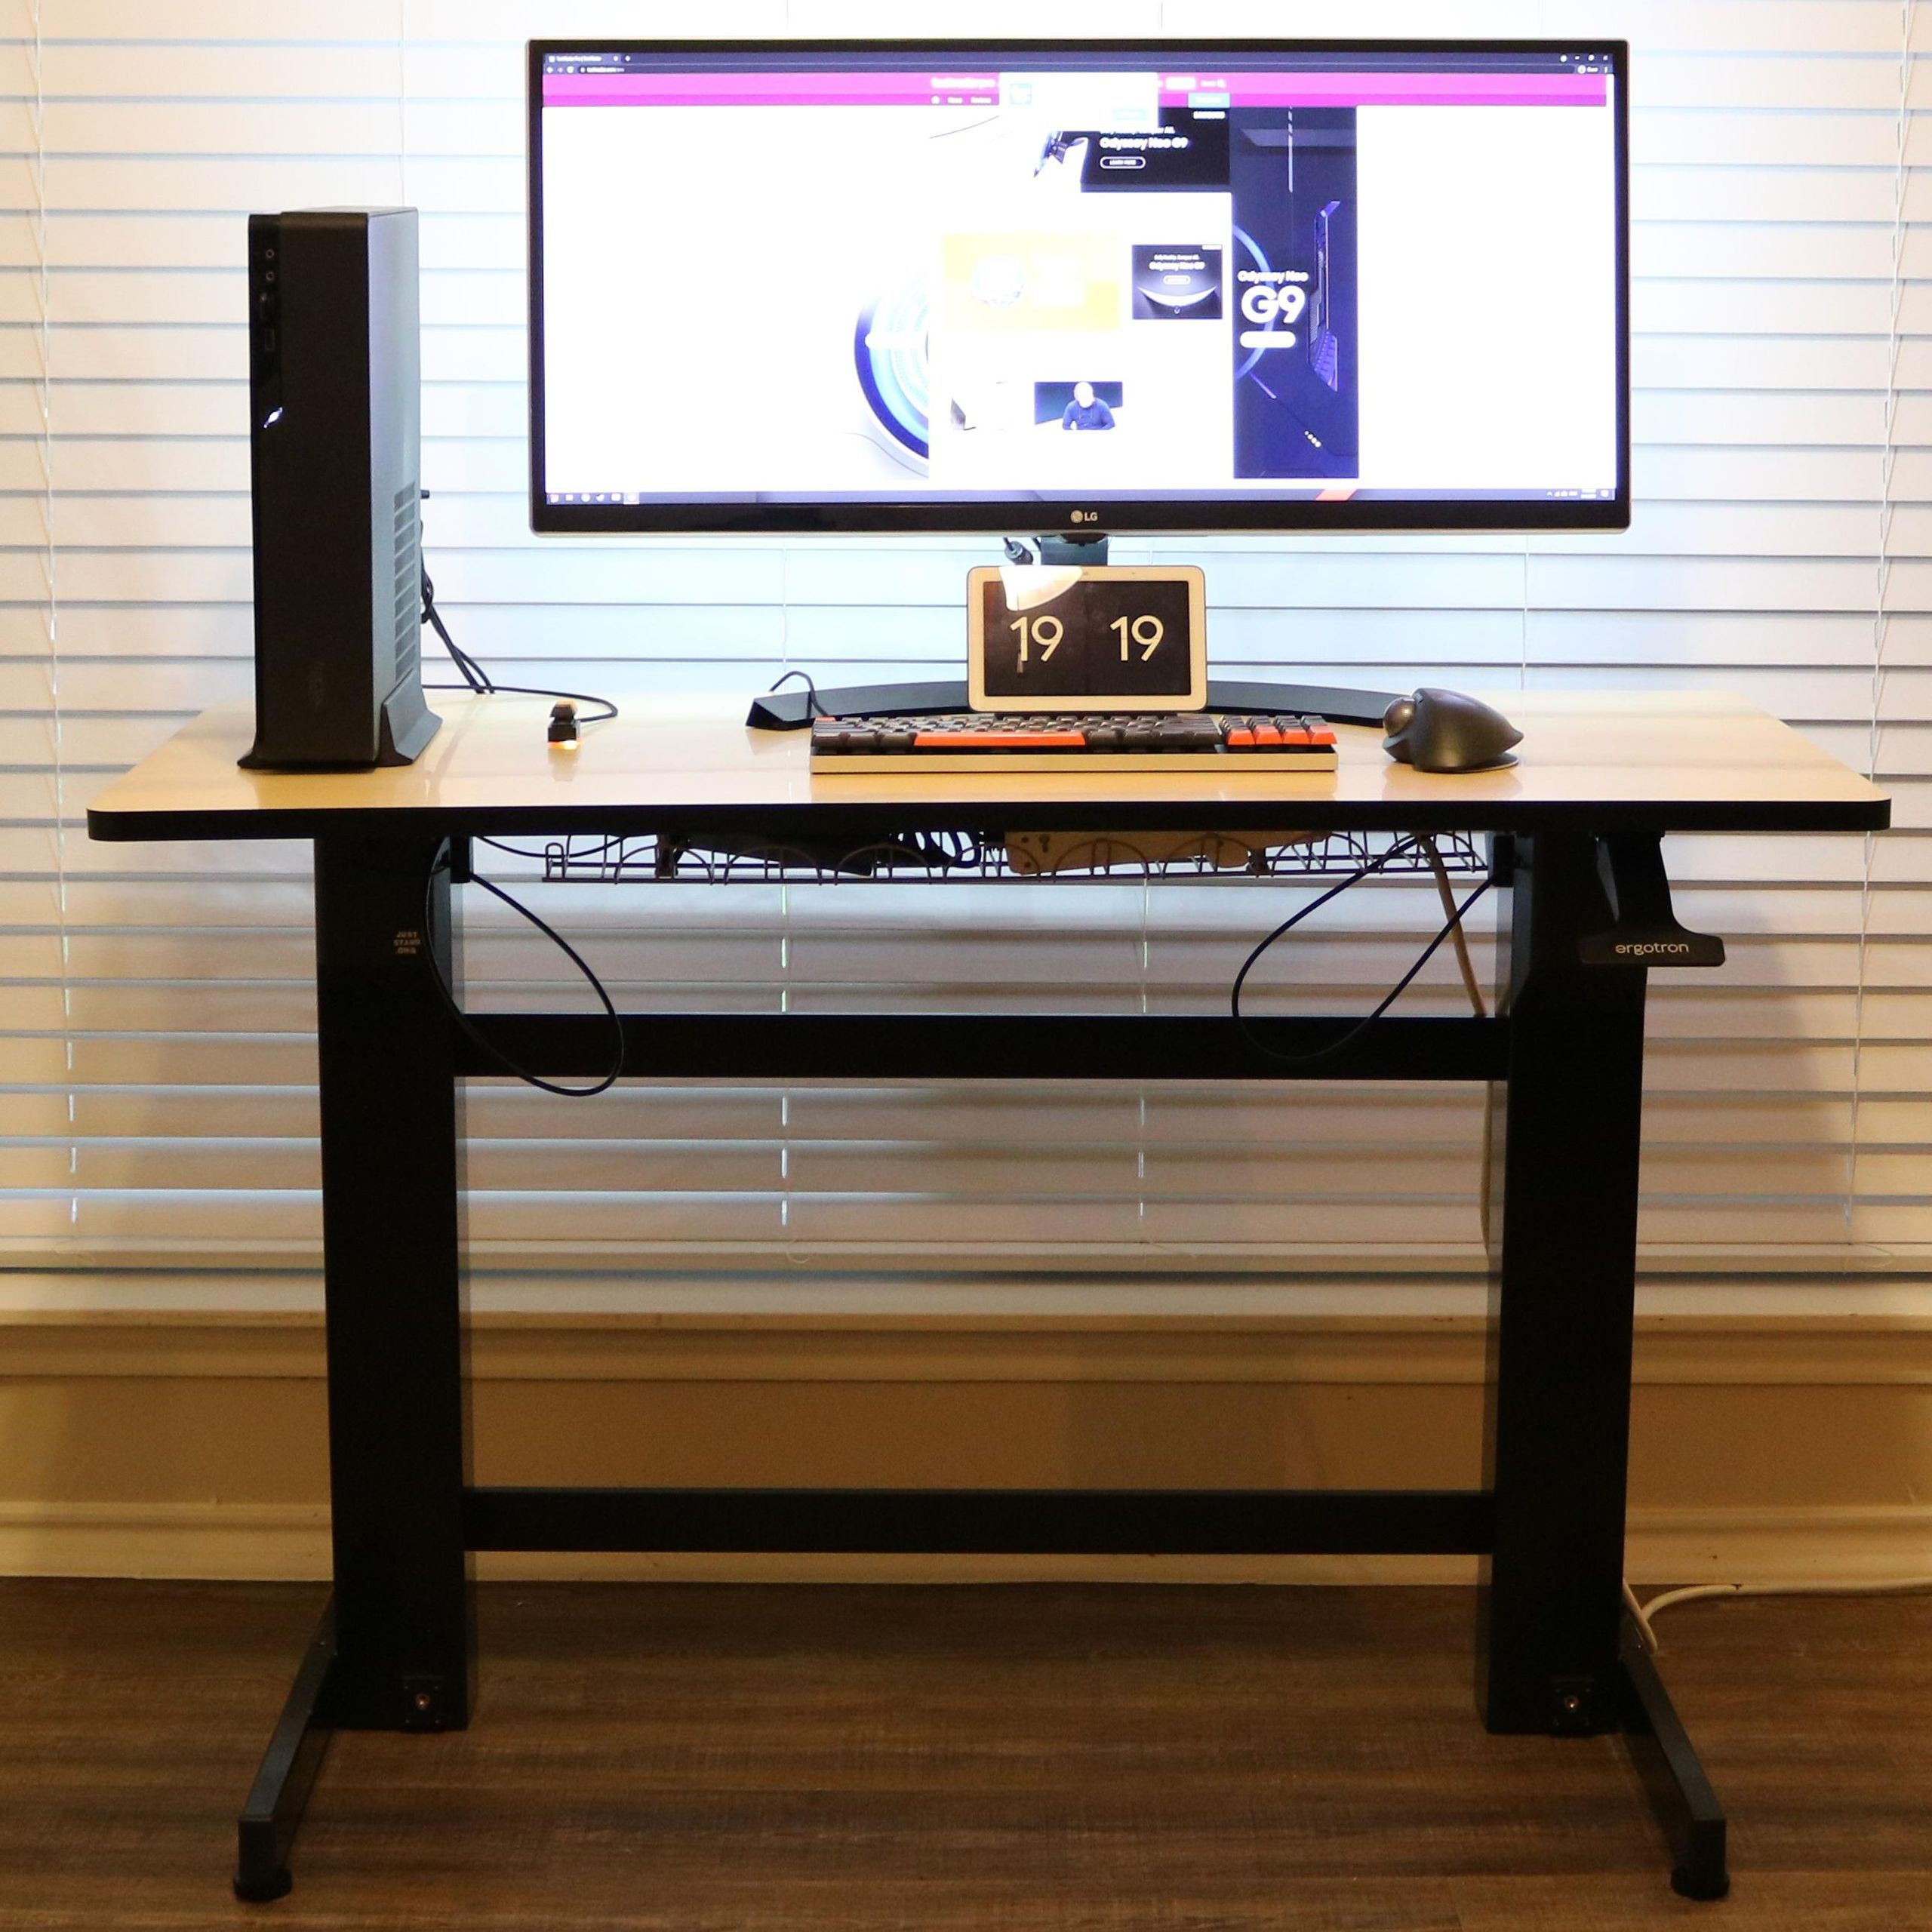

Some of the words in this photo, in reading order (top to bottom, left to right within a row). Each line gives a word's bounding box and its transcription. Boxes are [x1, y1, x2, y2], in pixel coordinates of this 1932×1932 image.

[1100, 137, 1148, 150] Odyssey
[1238, 270, 1284, 285] Odyssey
[1285, 270, 1309, 282] Neo
[1241, 285, 1306, 324] G9
[1084, 511, 1098, 521] LG
[1010, 614, 1064, 662] 19
[1109, 614, 1164, 662] 19
[1615, 942, 1690, 956] ergotron
